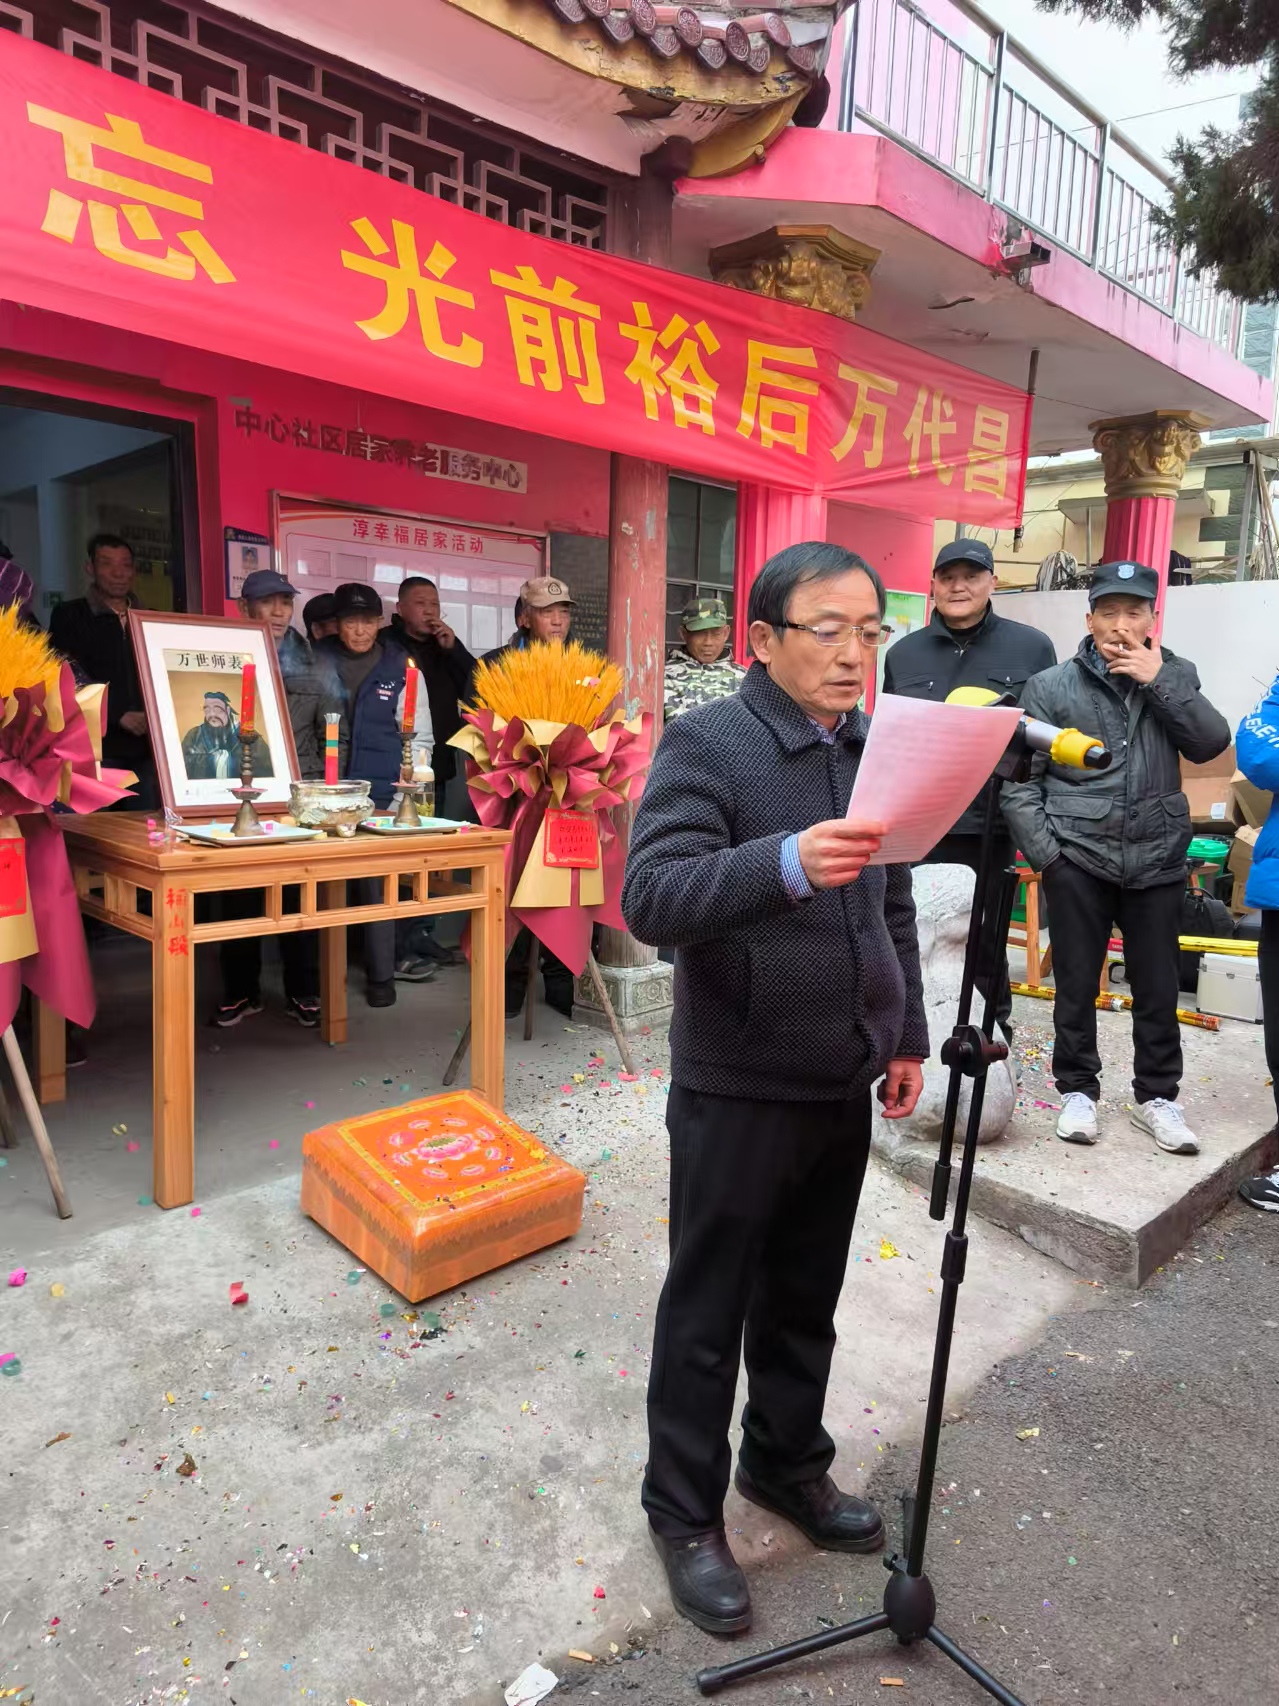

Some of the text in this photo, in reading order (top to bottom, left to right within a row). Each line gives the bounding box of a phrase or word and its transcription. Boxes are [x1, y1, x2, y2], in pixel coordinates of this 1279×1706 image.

[26, 101, 1010, 500] 忘 光前裕后万代昌
[353, 519, 484, 553] 淳幸福居家活动
[177, 652, 243, 670] 万世师表
